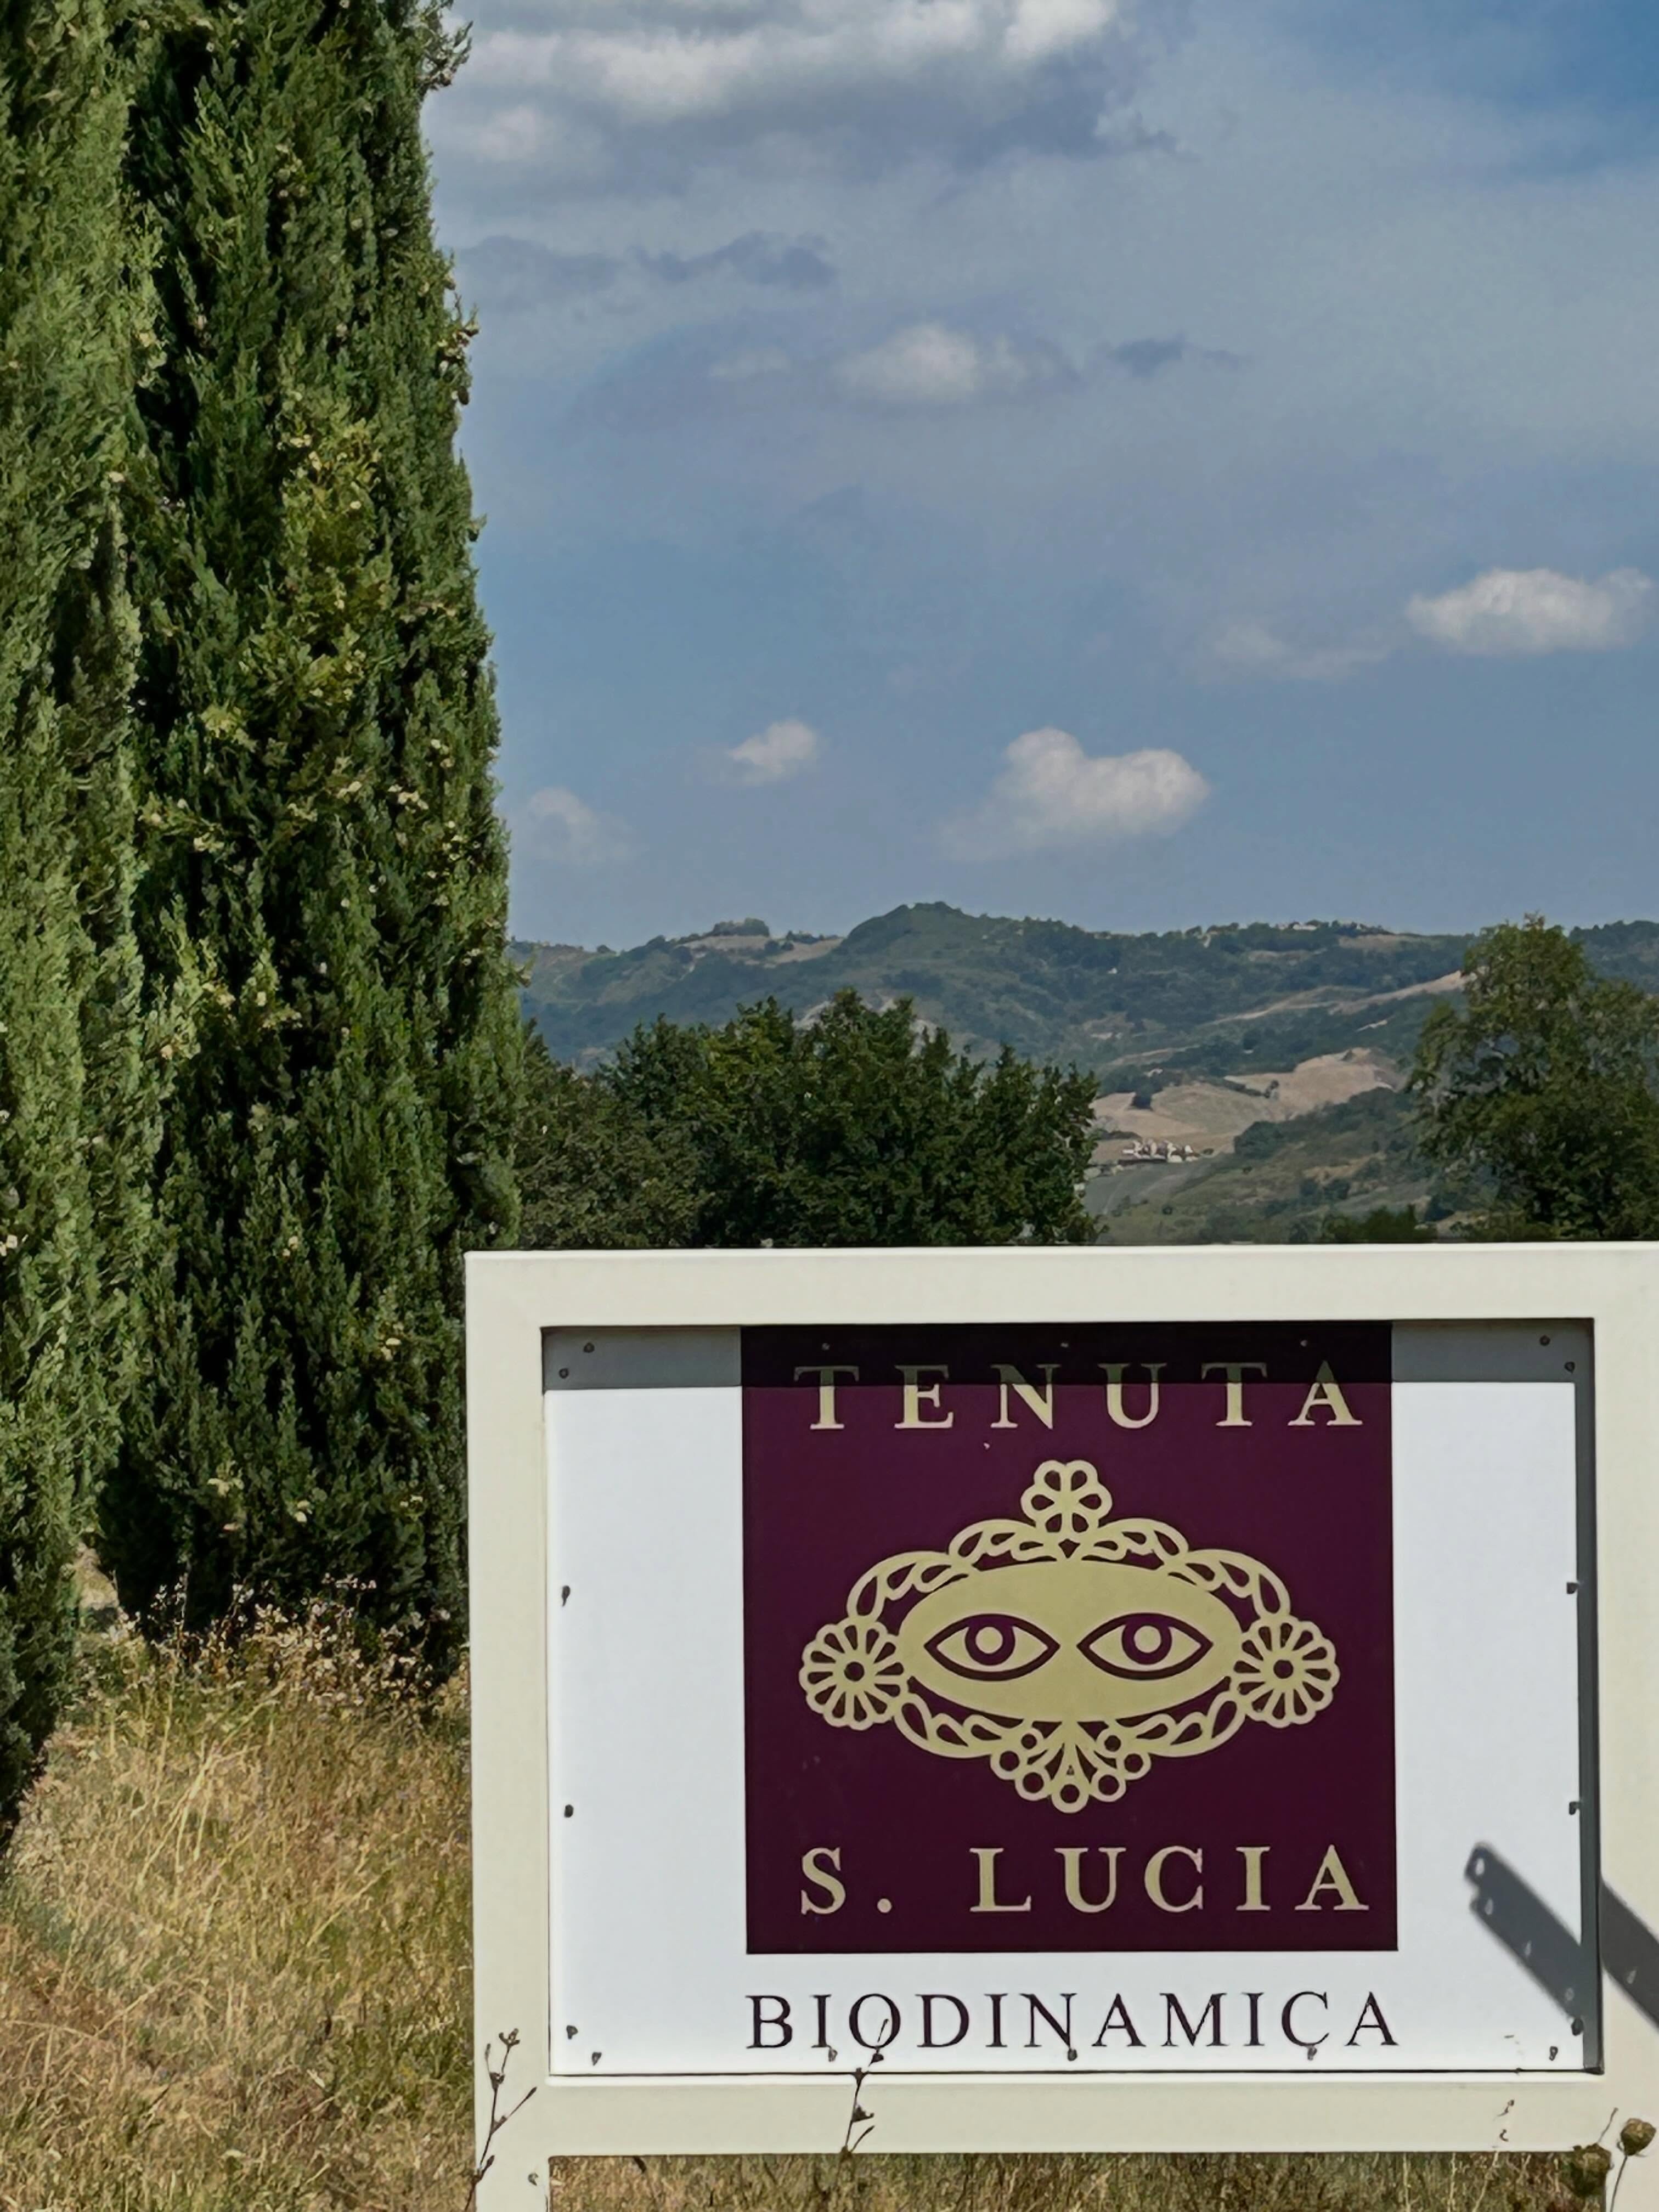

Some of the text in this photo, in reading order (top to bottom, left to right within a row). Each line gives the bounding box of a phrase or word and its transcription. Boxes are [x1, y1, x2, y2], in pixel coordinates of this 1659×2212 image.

[793, 1362, 1363, 1431] TENUTA
[800, 1844, 1369, 1914] S. LUCIA
[745, 1991, 1398, 2050] BIODINAMICA
